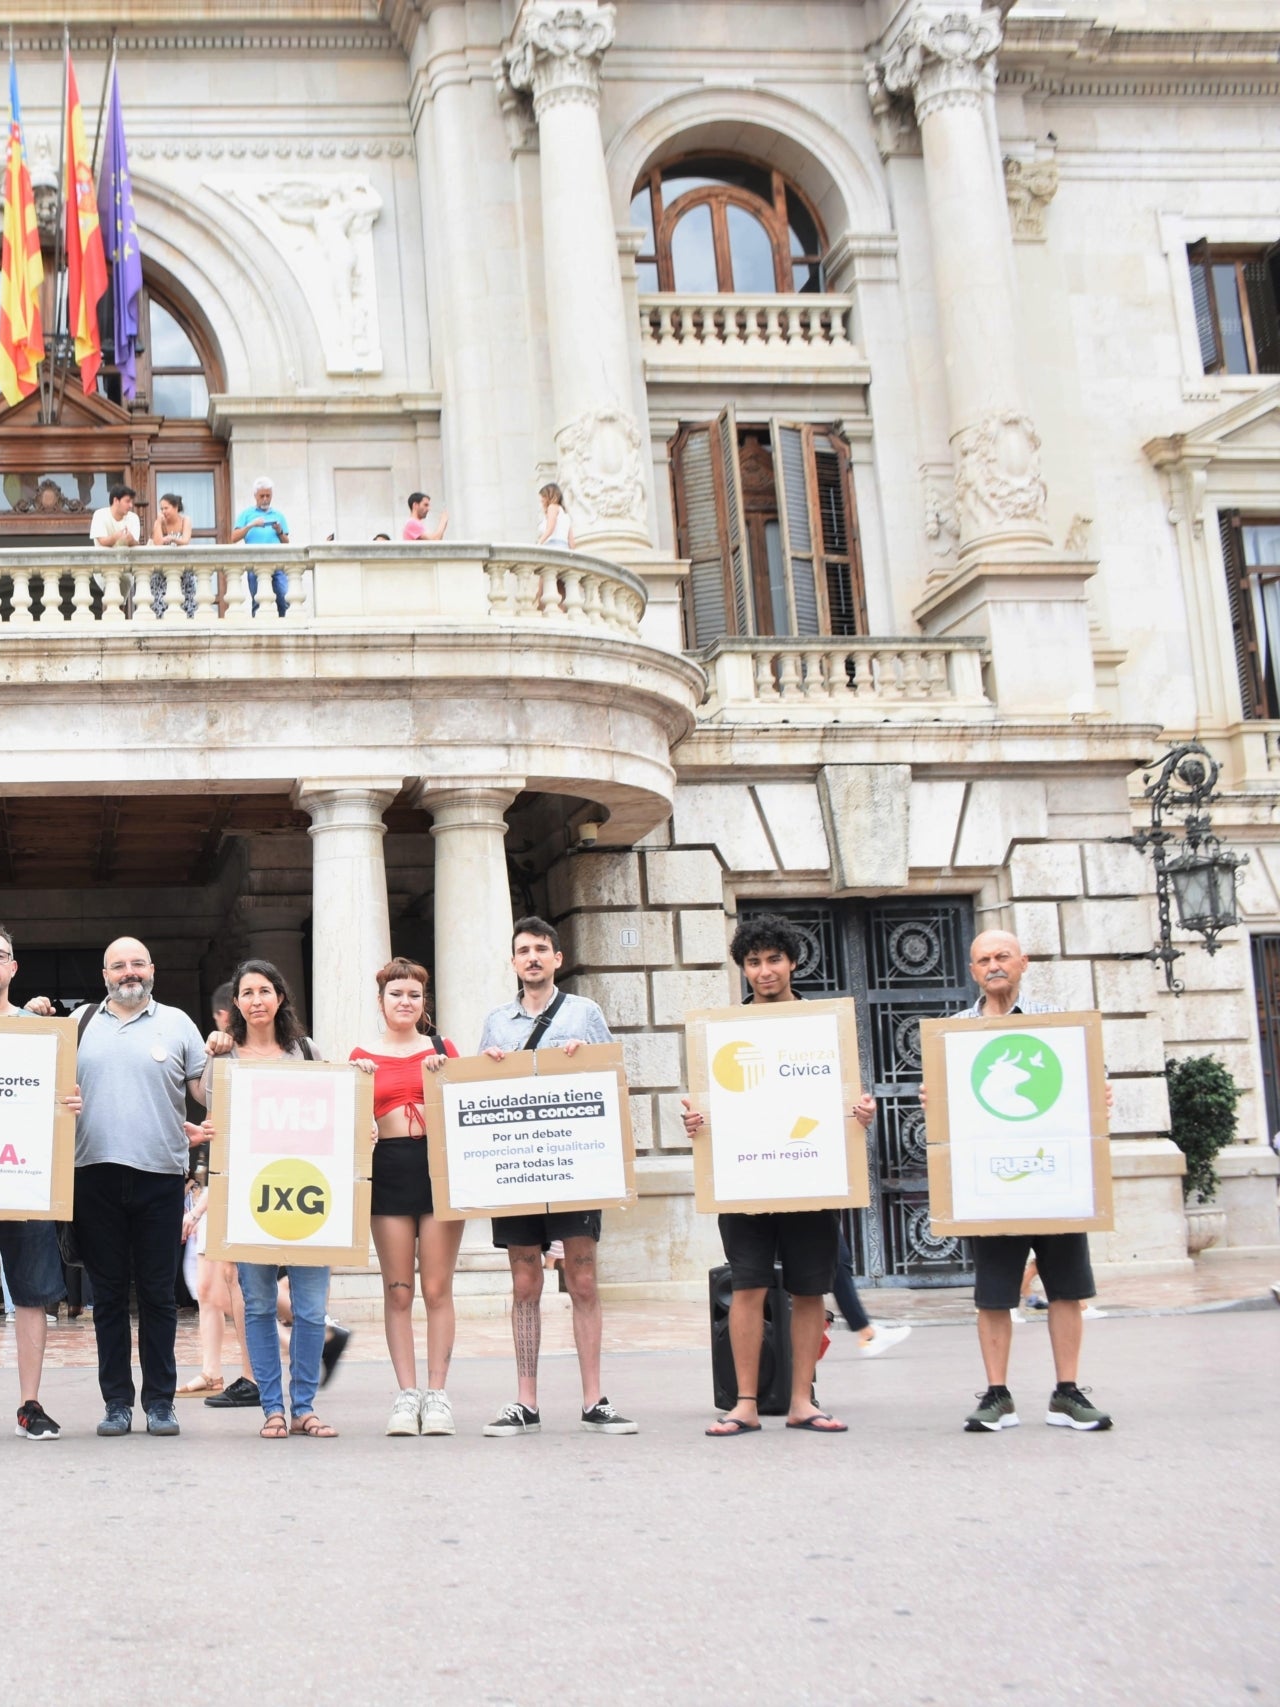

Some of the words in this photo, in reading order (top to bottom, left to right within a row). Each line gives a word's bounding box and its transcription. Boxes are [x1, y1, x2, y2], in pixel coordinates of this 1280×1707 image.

[778, 1050, 835, 1061] Fuerza
[778, 1063, 832, 1077] Cívica
[458, 1098, 476, 1110] La
[479, 1091, 560, 1108] ciudadanía
[564, 1089, 604, 1102] tiene
[462, 1110, 524, 1125] derecho
[526, 1110, 536, 1120] a
[538, 1104, 602, 1120] conocer
[492, 1132, 512, 1142] Por
[514, 1132, 530, 1140] un
[532, 1128, 572, 1140] debate
[463, 1145, 534, 1161] proporcional
[536, 1146, 544, 1154] e
[546, 1140, 606, 1154] igualitario
[738, 1154, 758, 1163] por
[761, 1150, 776, 1160] mi
[779, 1148, 818, 1161] región
[495, 1161, 520, 1172] para
[522, 1157, 555, 1168] todas
[557, 1156, 574, 1166] las
[990, 1155, 1056, 1174] PUEDE
[496, 1171, 574, 1185] candidaturas.
